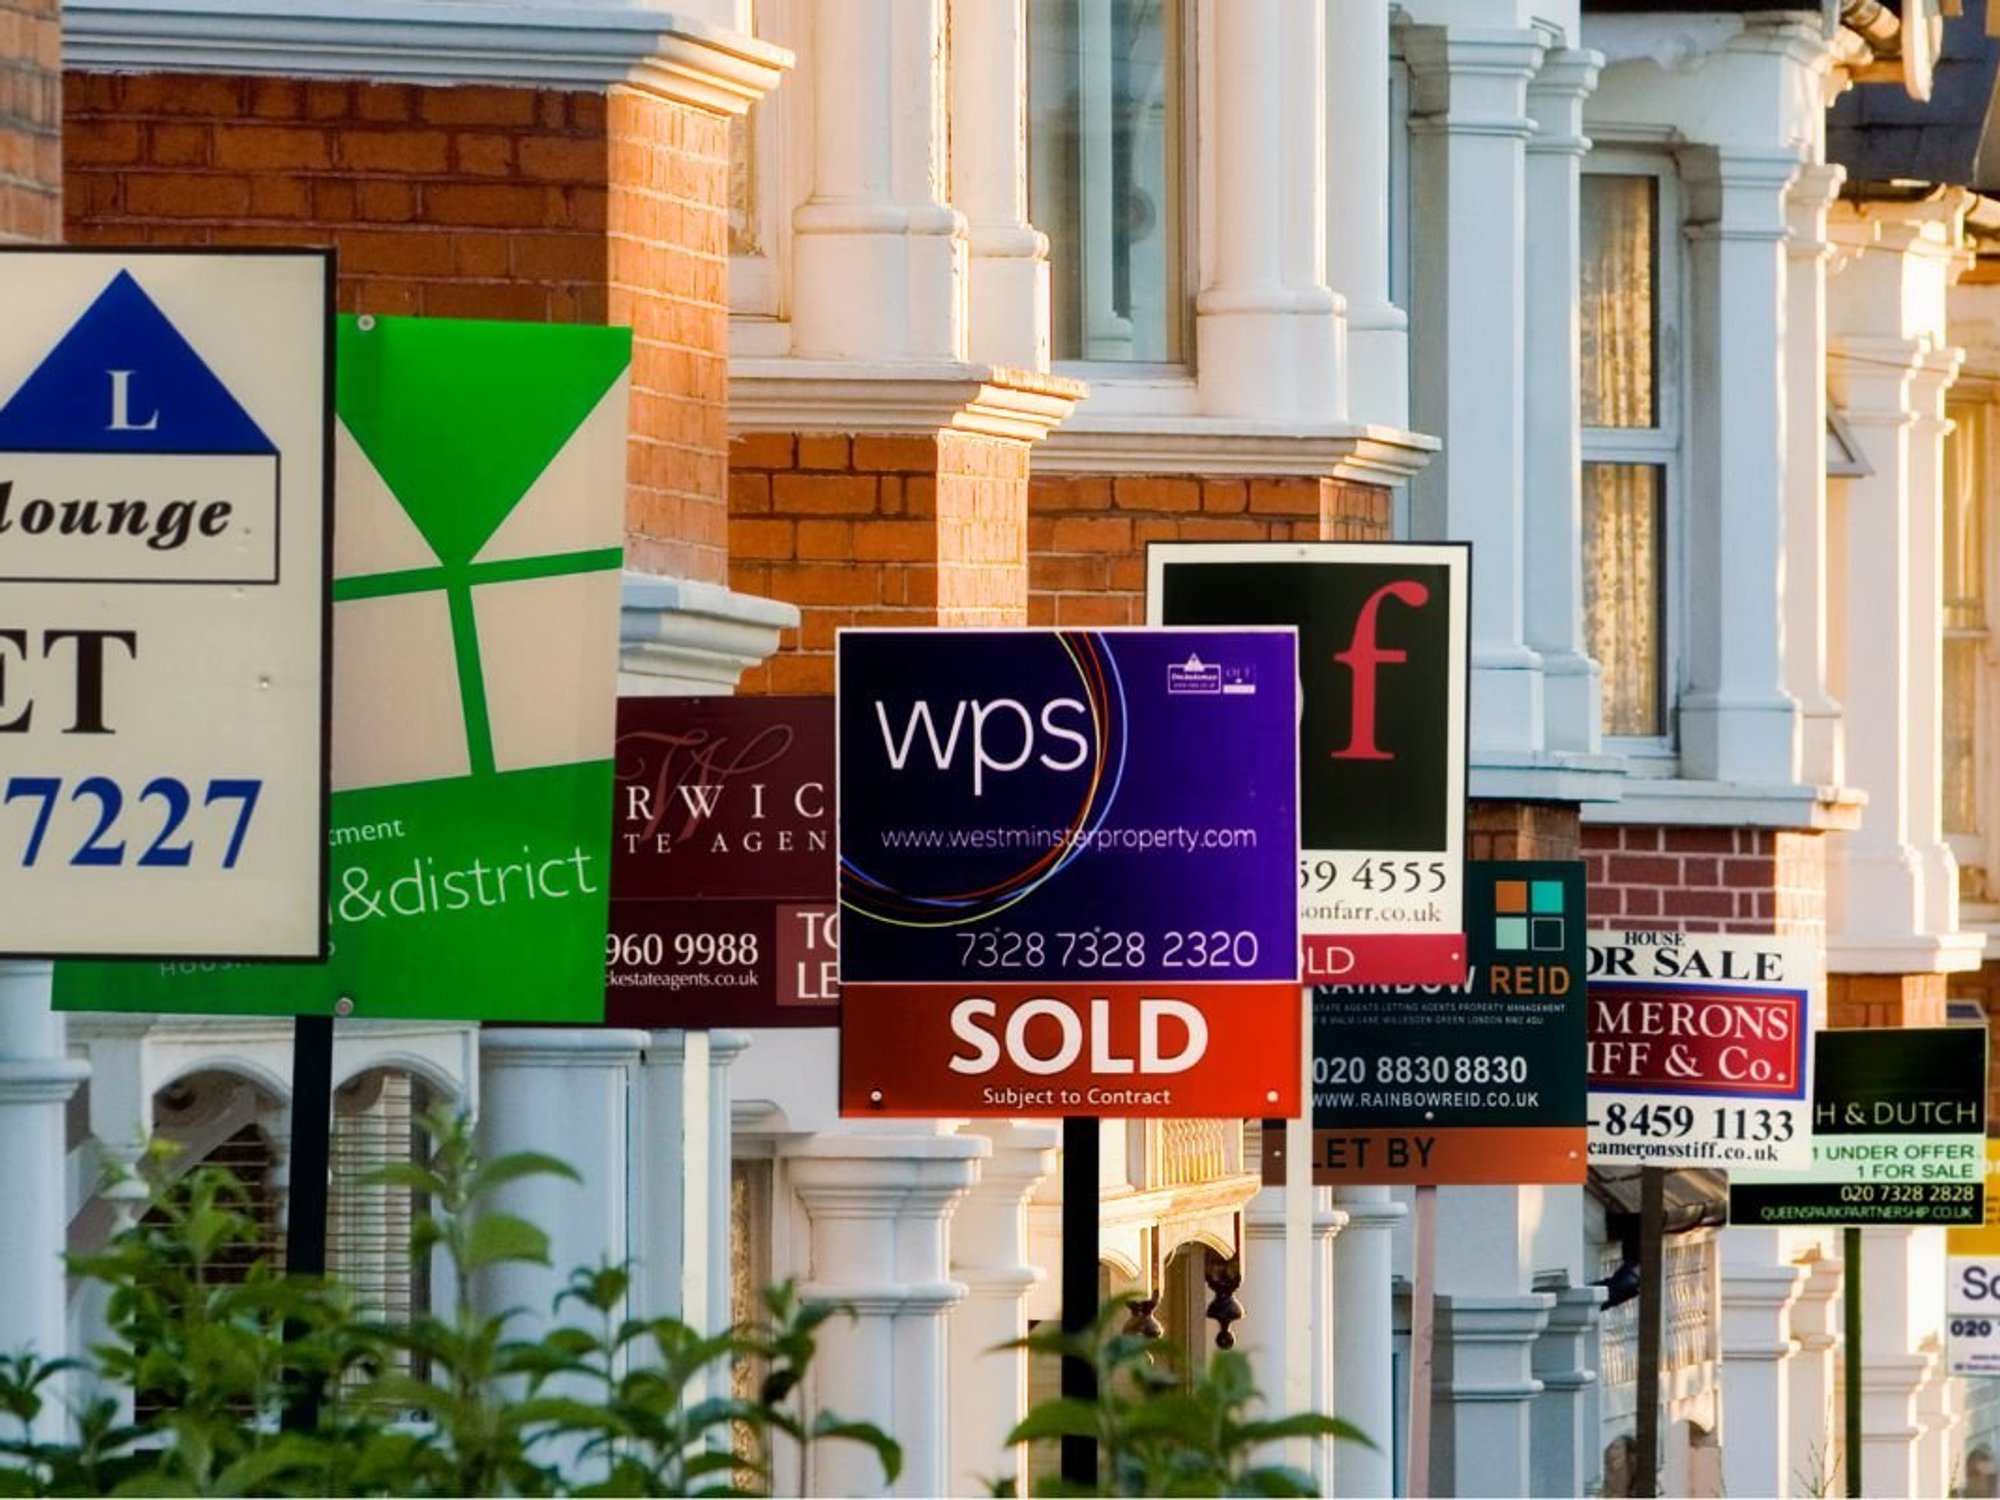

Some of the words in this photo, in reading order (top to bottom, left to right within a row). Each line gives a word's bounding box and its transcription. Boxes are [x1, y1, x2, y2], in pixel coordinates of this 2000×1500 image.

[105, 370, 158, 431] L
[1331, 580, 1429, 760] f
[875, 697, 1089, 796] wps
[4, 776, 263, 869] 7227
[881, 825, 1257, 853] www.westminsterproperty.com
[329, 844, 598, 922] &district
[1352, 858, 1446, 893] 4555
[674, 933, 759, 966] 9988
[956, 931, 1045, 968] 7328
[1055, 931, 1146, 968] 7328
[1162, 931, 1259, 968] 2320
[1625, 931, 1685, 946] HOUSE
[1301, 946, 1355, 974] LD
[1653, 947, 1783, 981] SALE
[1489, 965, 1570, 995] REID
[948, 998, 1209, 1075] SOLD
[1596, 1000, 1789, 1041] MERONS
[1313, 1057, 1365, 1083] 020
[1377, 1056, 1449, 1083] 8830
[1454, 1056, 1527, 1083] 8830
[1664, 1043, 1703, 1077] &
[1718, 1045, 1787, 1081] Co.
[983, 1087, 1055, 1106] Subject
[1060, 1088, 1081, 1105] to
[1088, 1087, 1171, 1105] Contract
[1312, 1092, 1539, 1108] WWW.RAINBOWREID.CO.UK
[1714, 1107, 1794, 1142] 1133
[1844, 1102, 1867, 1125] &
[1873, 1101, 1977, 1125] DUTCH
[1312, 1137, 1371, 1168] ET
[1388, 1137, 1435, 1168] BY
[1826, 1145, 1898, 1160] UNDER
[1904, 1144, 1975, 1160] OFFER
[1858, 1165, 1864, 1179] 1
[1873, 1164, 1916, 1179] FOR
[1922, 1164, 1974, 1179] SALE
[1841, 1185, 1874, 1201] 020
[1880, 1185, 1923, 1201] 7328
[1929, 1185, 1974, 1201] 2828
[1950, 1319, 1992, 1337] 020
